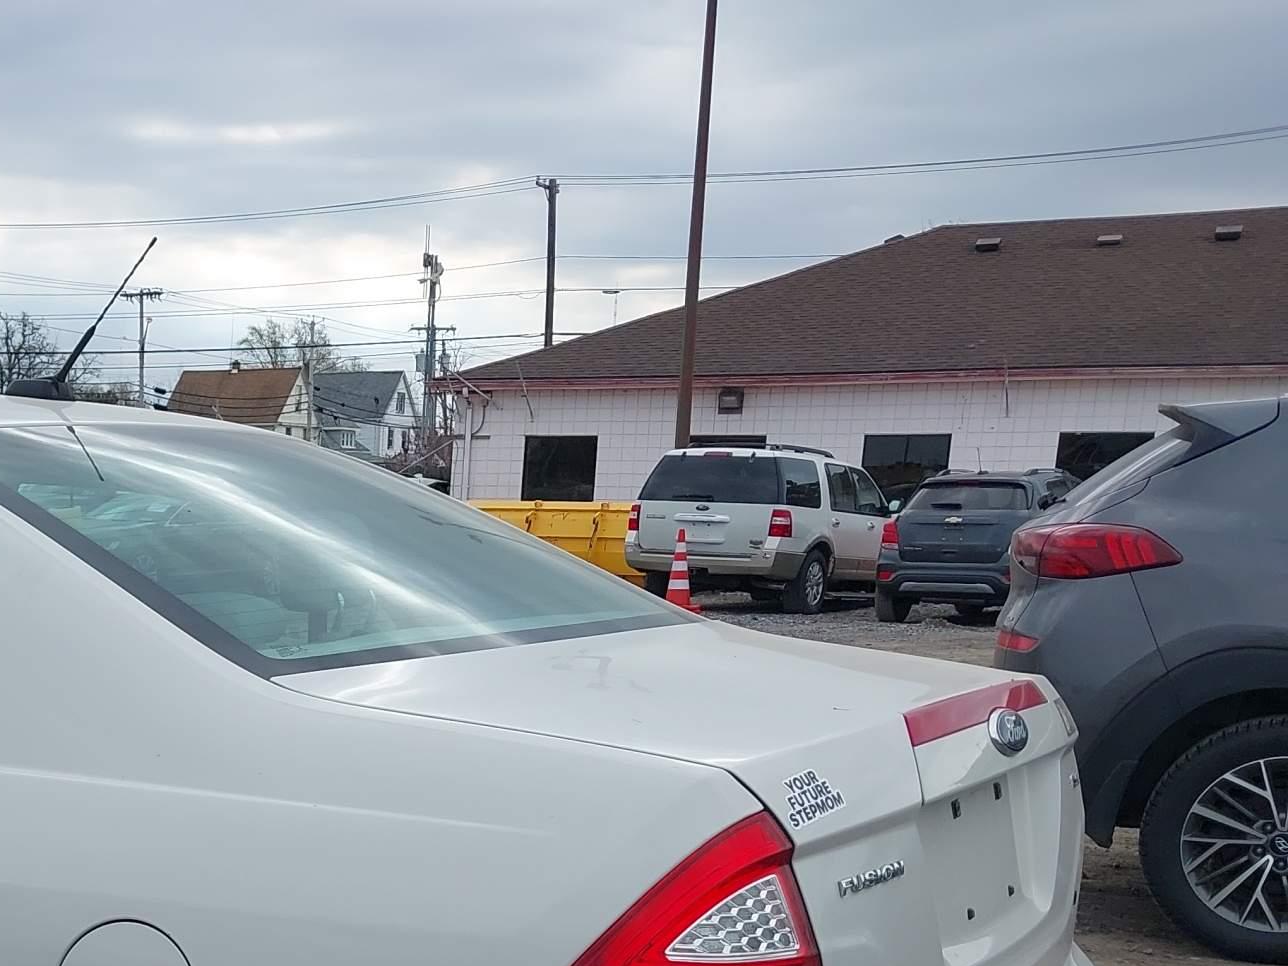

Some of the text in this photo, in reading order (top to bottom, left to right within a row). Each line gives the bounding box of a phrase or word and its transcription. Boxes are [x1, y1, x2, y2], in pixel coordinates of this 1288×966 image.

[1004, 715, 1027, 743] Ford
[784, 770, 819, 793] YOUR
[787, 781, 832, 811] FUTURE
[789, 792, 845, 827] STEPMOM
[837, 860, 905, 897] FUSION
